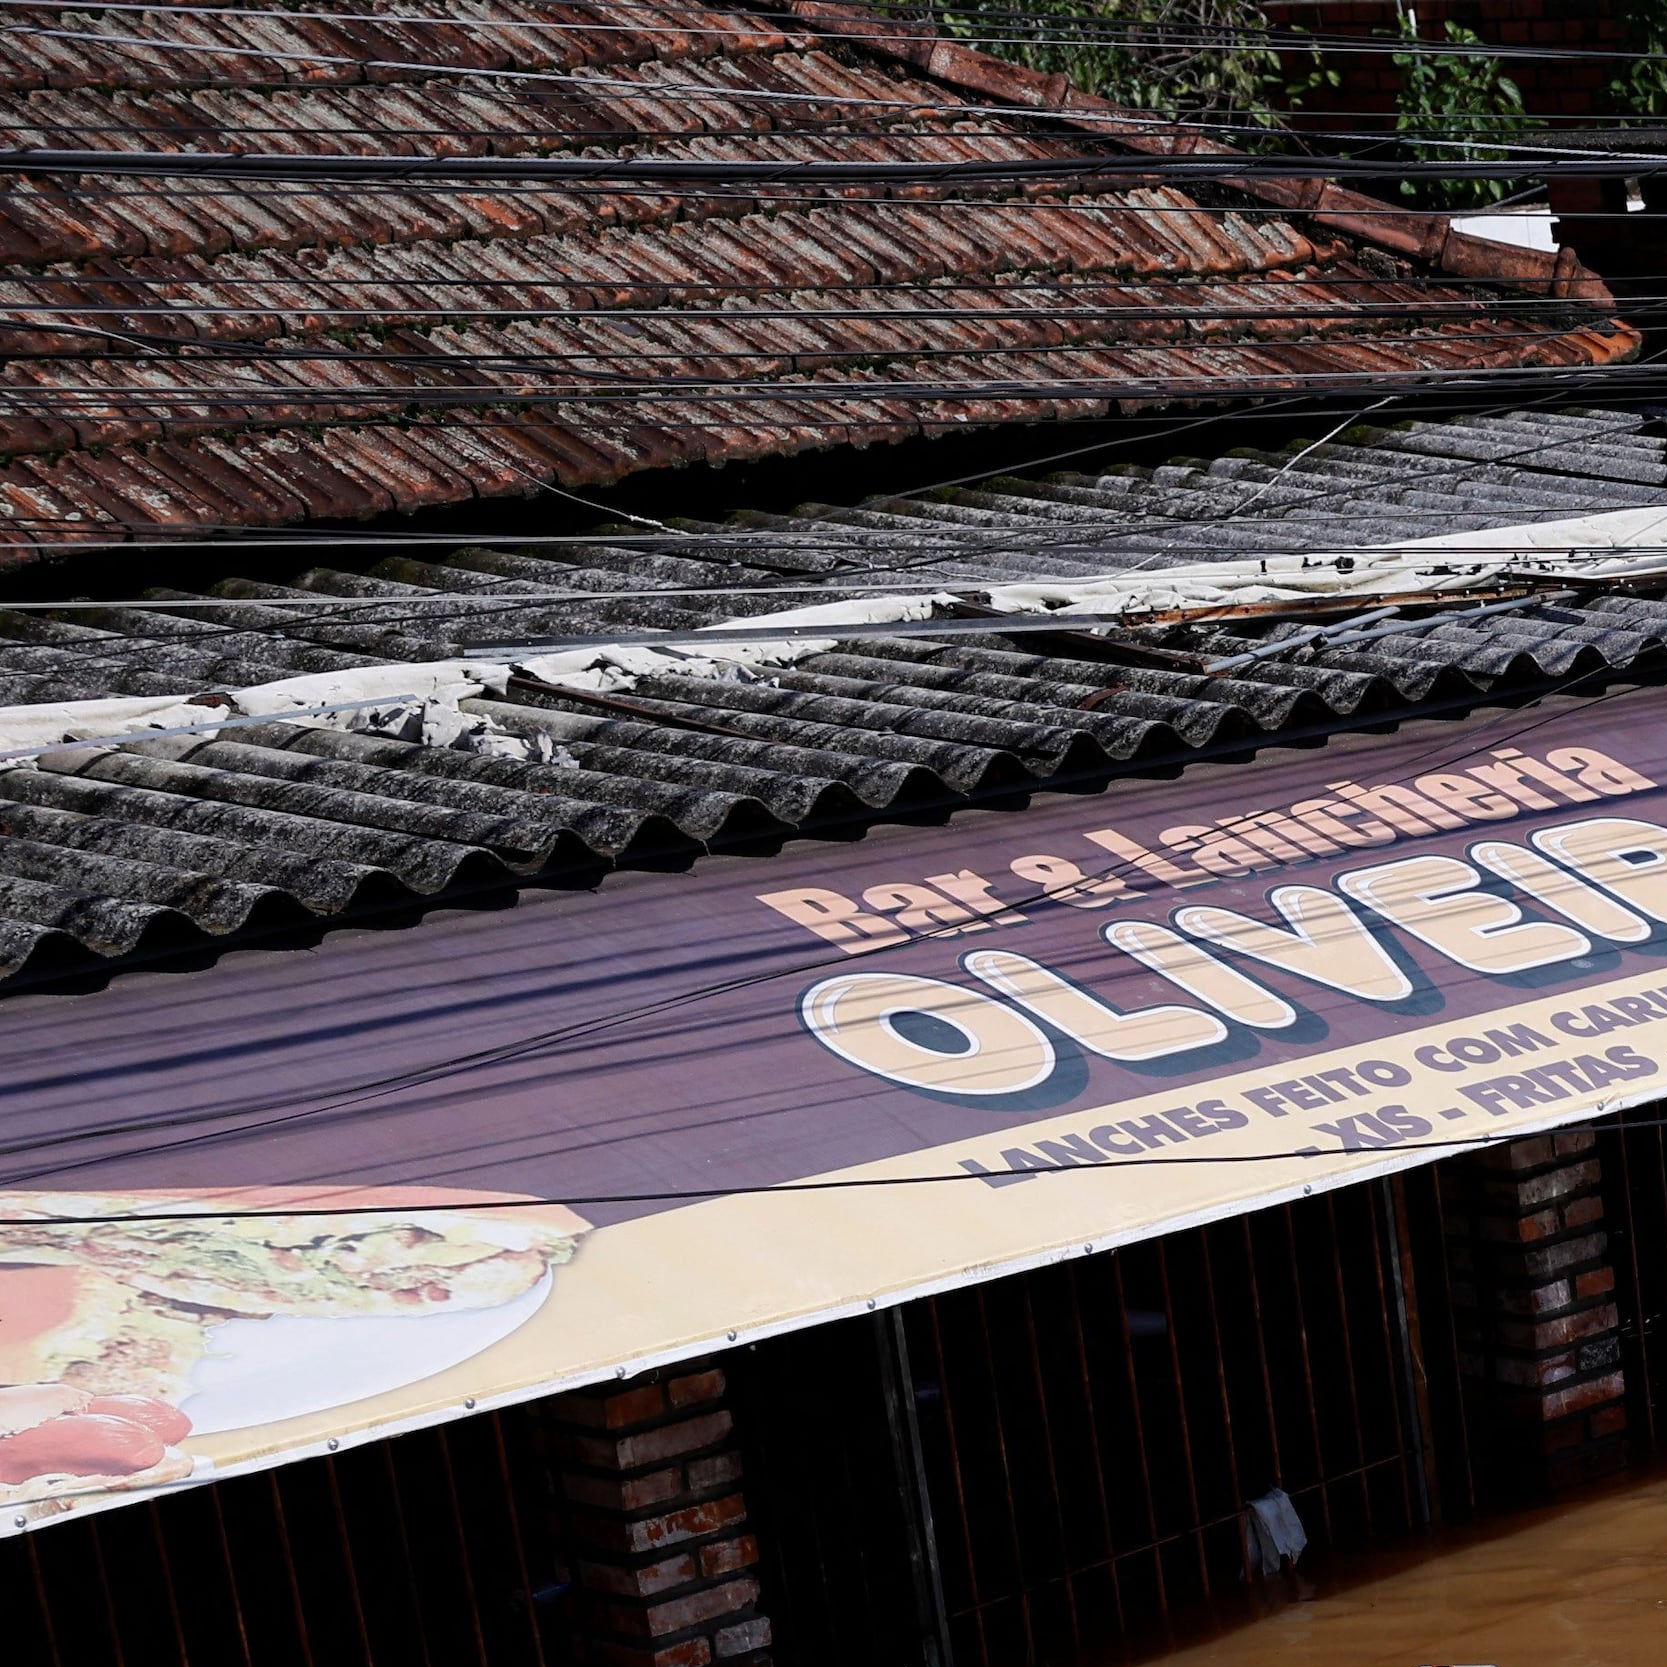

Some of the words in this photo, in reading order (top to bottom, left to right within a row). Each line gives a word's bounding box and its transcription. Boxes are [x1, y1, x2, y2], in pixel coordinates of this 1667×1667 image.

[757, 868, 1027, 955] Bar
[1010, 855, 1148, 908] &
[1083, 747, 1658, 890] Lancheria
[958, 1099, 1249, 1189] LANCHES
[1240, 1060, 1412, 1119] FEITO
[1414, 1024, 1560, 1073] COM
[1309, 1104, 1434, 1158] XIS
[1454, 1046, 1659, 1116] FRITAS
